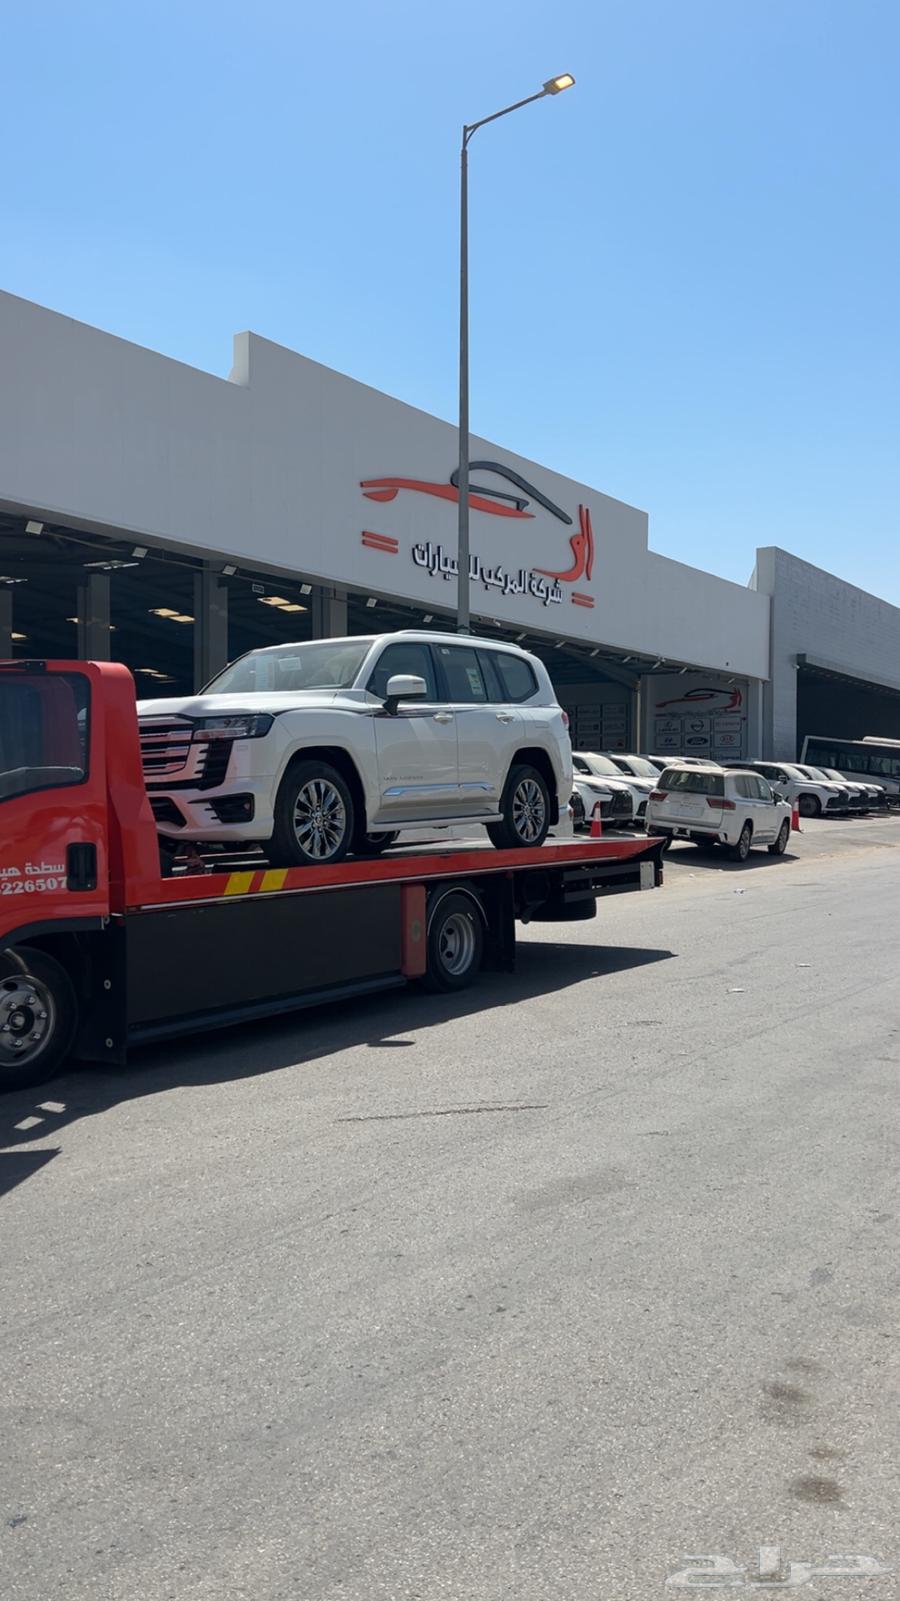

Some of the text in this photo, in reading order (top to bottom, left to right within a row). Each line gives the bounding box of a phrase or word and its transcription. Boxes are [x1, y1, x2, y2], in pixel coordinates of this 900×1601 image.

[480, 564, 528, 595] المركب
[527, 572, 563, 606] شركة
[25, 861, 65, 875] سطحة
[0, 876, 67, 895] 226507
